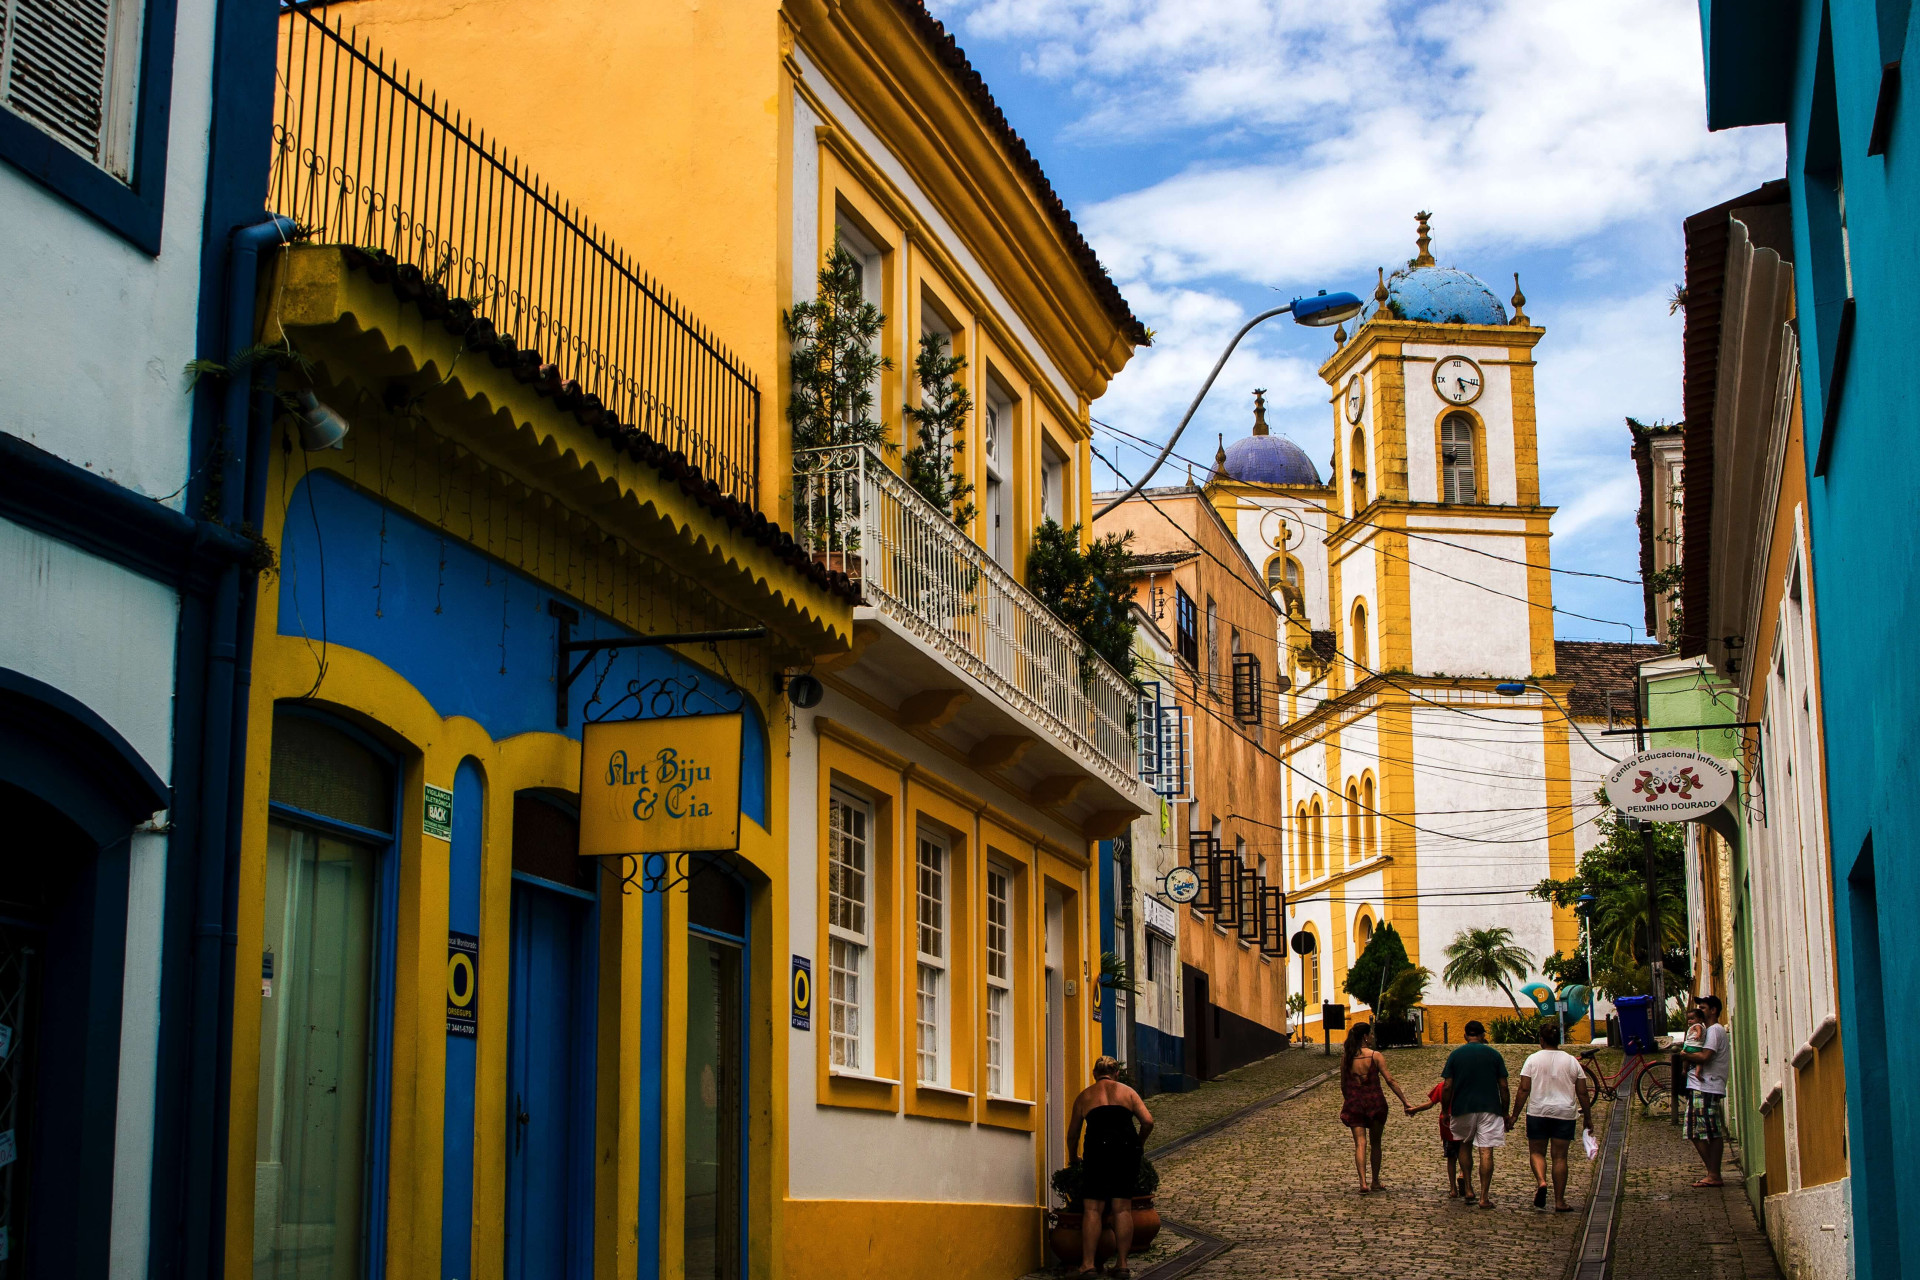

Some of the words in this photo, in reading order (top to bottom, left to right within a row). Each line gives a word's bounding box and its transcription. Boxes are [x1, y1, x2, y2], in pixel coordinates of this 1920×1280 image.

[605, 750, 649, 786] Art
[656, 748, 712, 788] Biju
[1611, 760, 1637, 783] Centro
[1638, 750, 1695, 763] Educacional
[1697, 754, 1728, 777] Infantil
[633, 787, 658, 821] &
[665, 783, 712, 818] Cia
[1627, 803, 1669, 813] PEIXINHO
[1671, 800, 1717, 811] DOURADO
